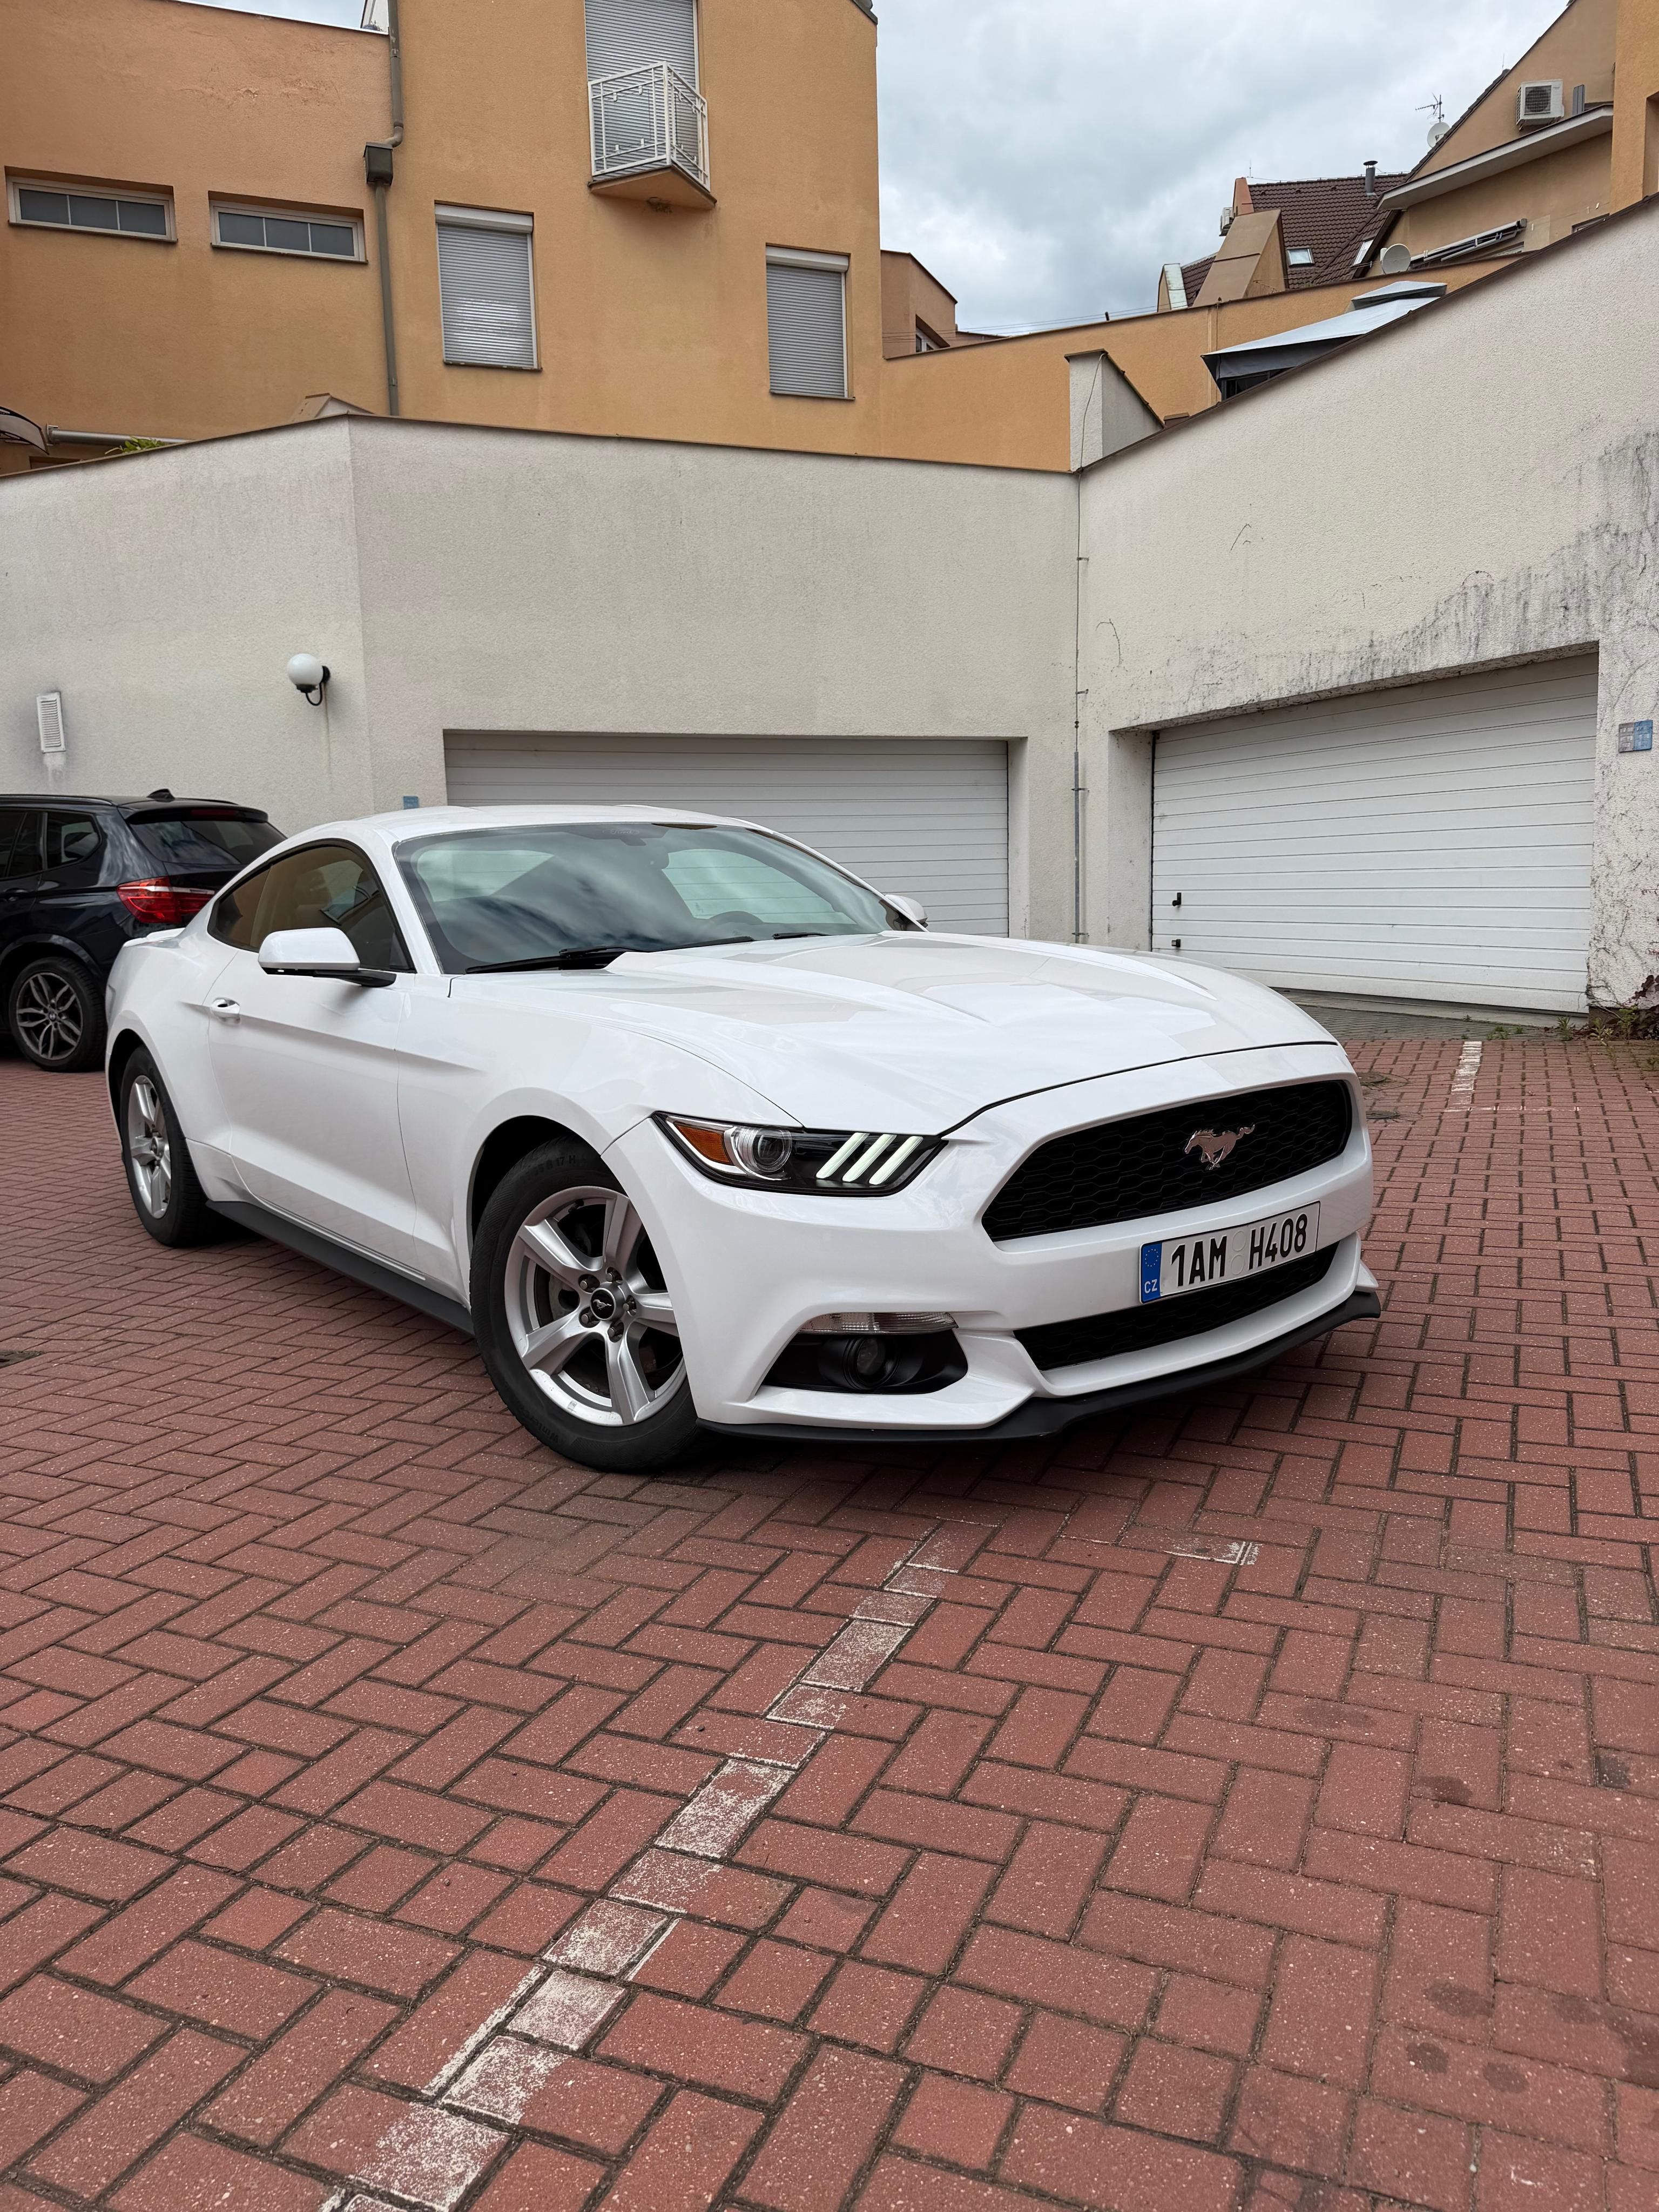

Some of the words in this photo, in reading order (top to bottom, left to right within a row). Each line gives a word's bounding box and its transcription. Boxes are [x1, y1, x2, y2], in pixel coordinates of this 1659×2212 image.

[568, 1154, 576, 1164] H
[1171, 1235, 1228, 1287] 1AM
[1248, 1213, 1308, 1271] H408
[1144, 1278, 1158, 1294] CZ
